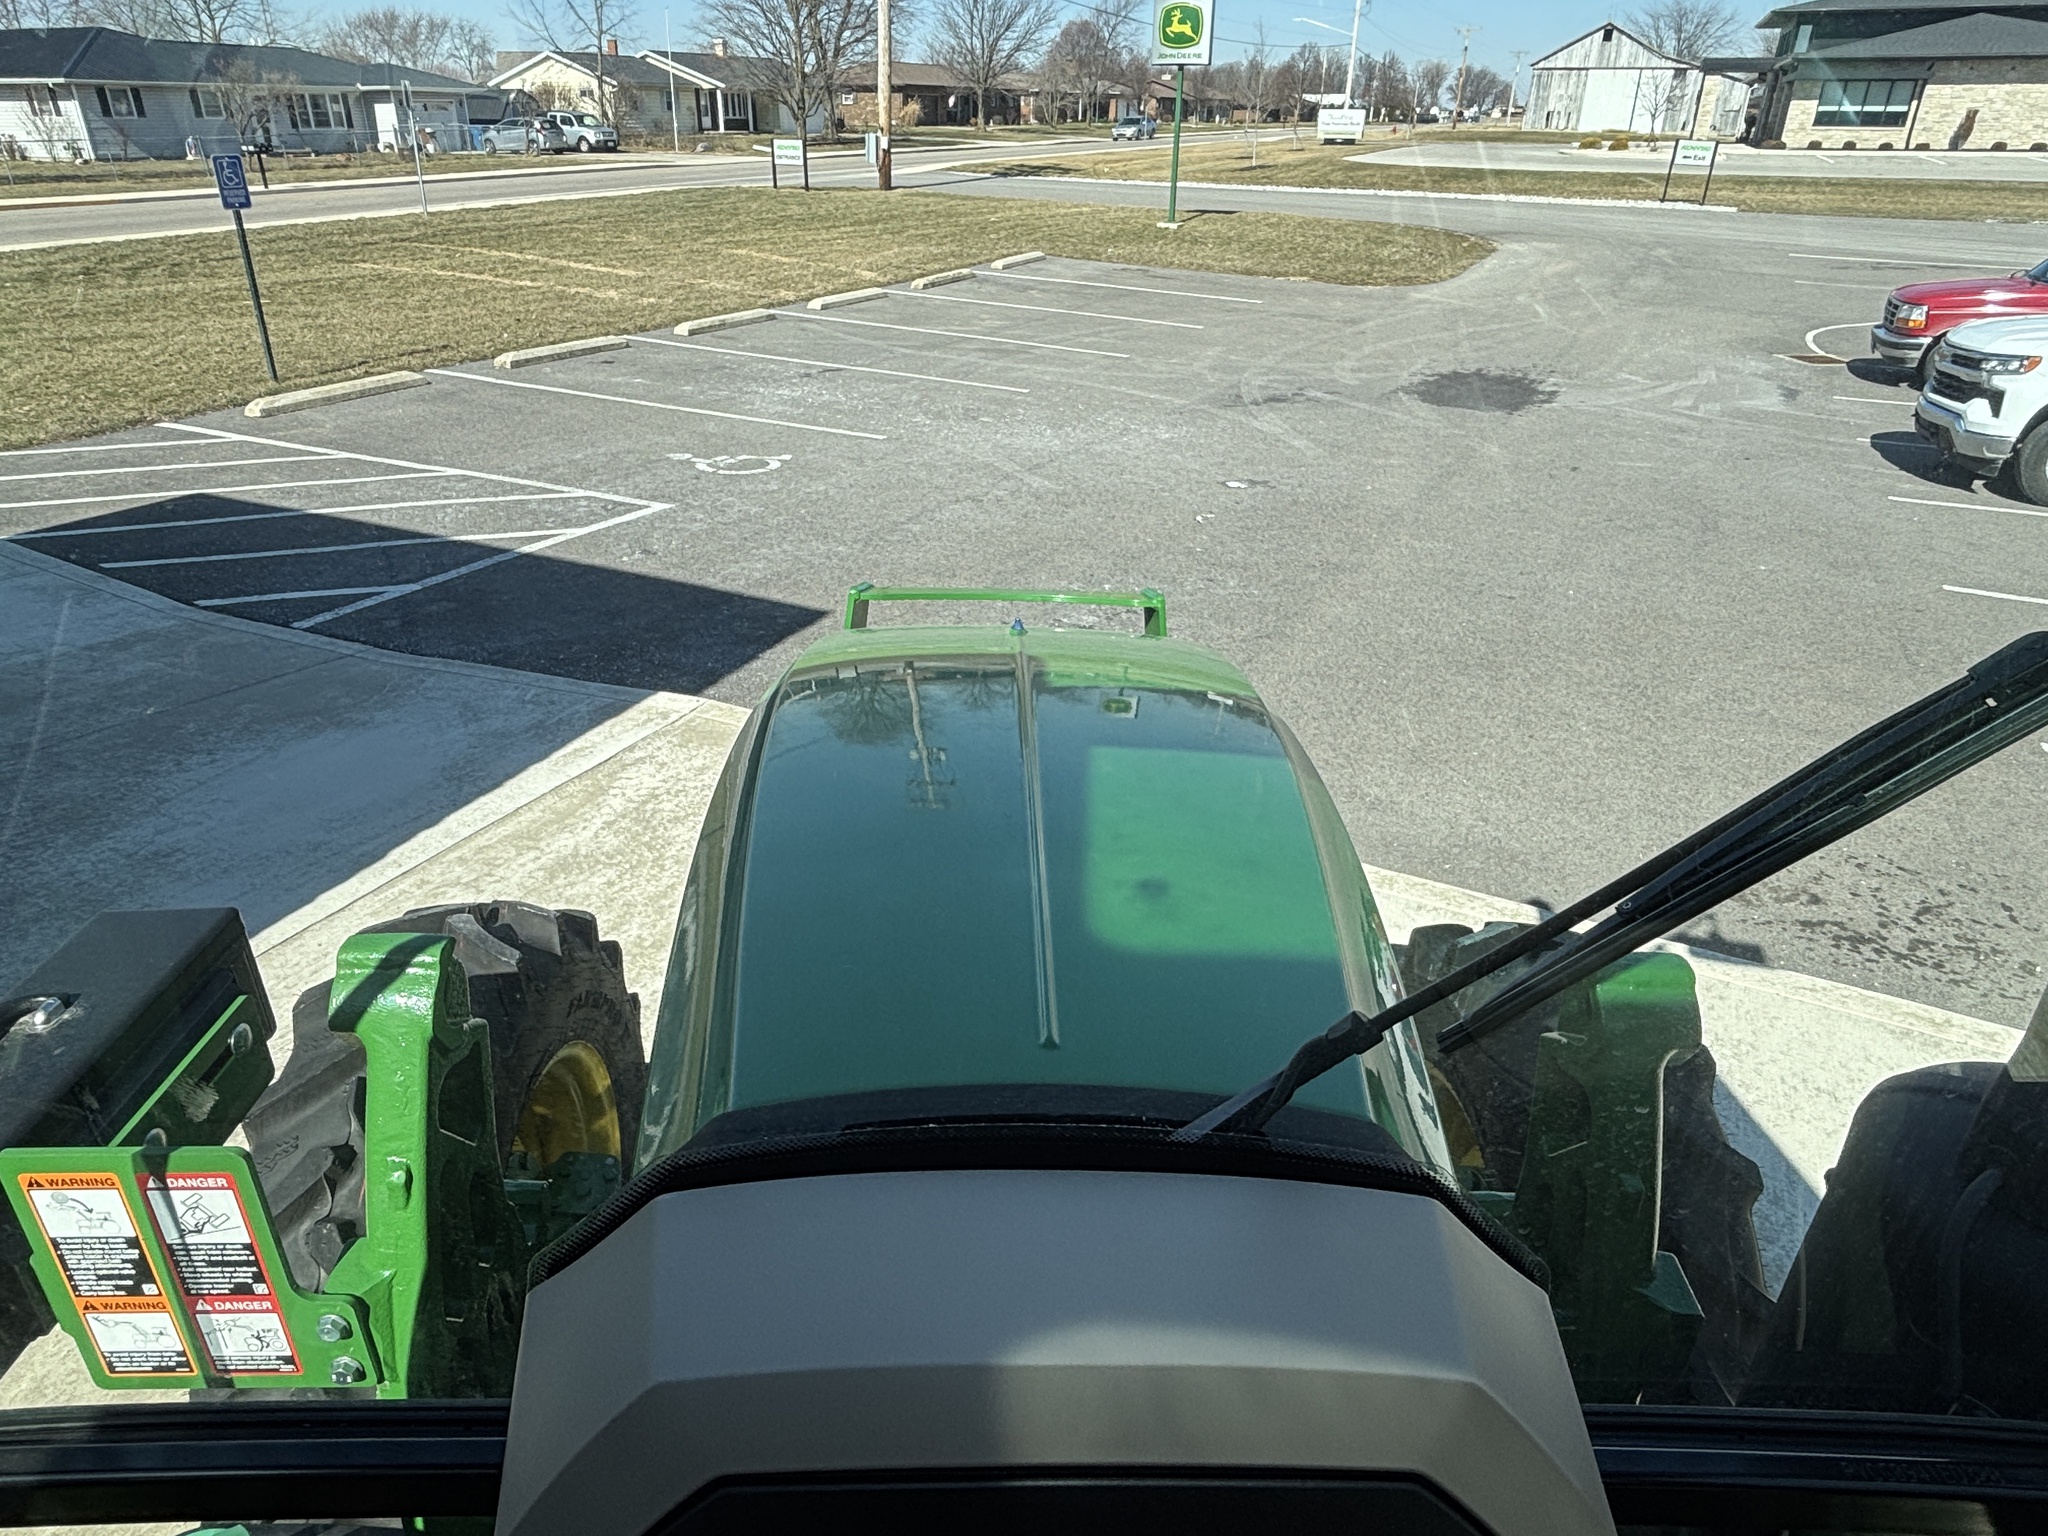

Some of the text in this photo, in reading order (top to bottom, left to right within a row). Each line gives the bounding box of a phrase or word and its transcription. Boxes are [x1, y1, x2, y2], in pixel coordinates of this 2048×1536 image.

[45, 1177, 116, 1187] WARNING
[166, 1177, 229, 1188] DANGER
[100, 1301, 167, 1310] WARNING
[213, 1301, 273, 1310] DANGER
